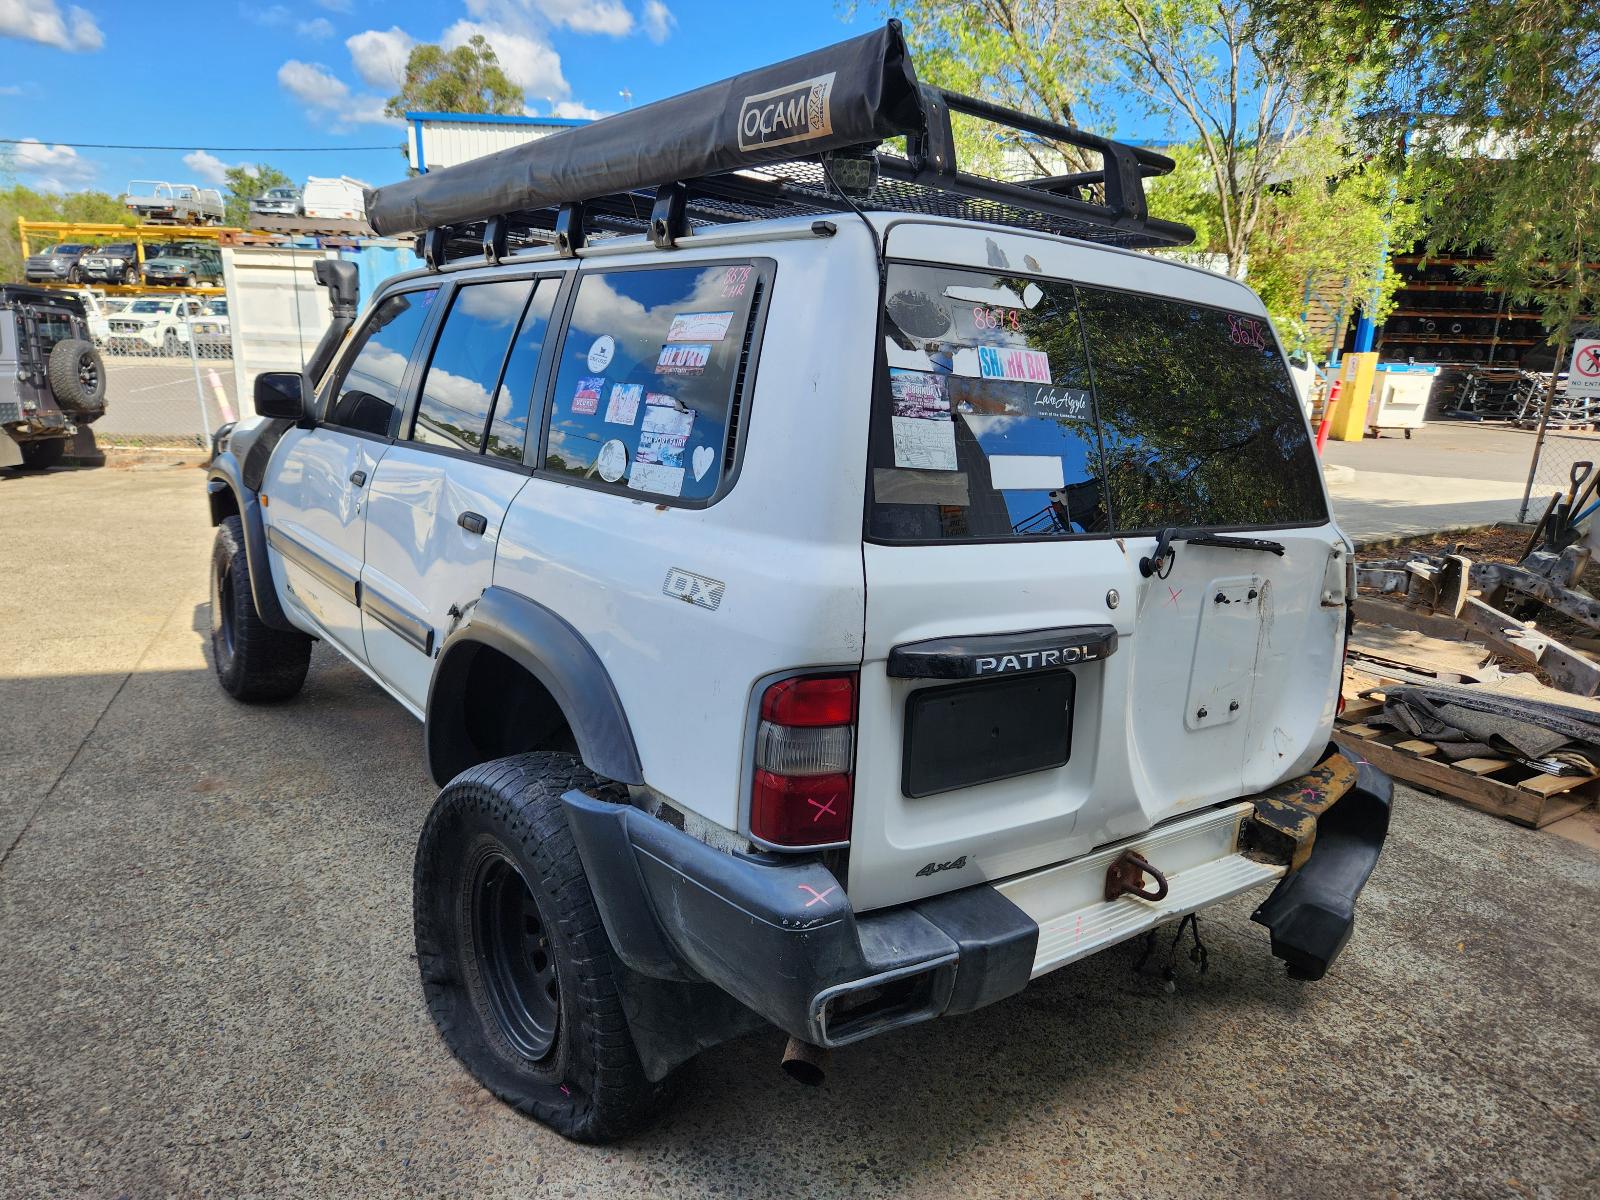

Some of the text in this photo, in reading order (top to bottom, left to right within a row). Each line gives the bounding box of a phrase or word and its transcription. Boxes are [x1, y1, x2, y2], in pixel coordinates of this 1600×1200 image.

[744, 95, 806, 137] OCAM
[724, 266, 752, 284] 8678
[973, 307, 1020, 330] 8678
[1025, 352, 1049, 381] BAY
[1034, 387, 1086, 414] Lake Argyle
[975, 645, 1098, 676] PATROL
[915, 855, 968, 877] 4x4
